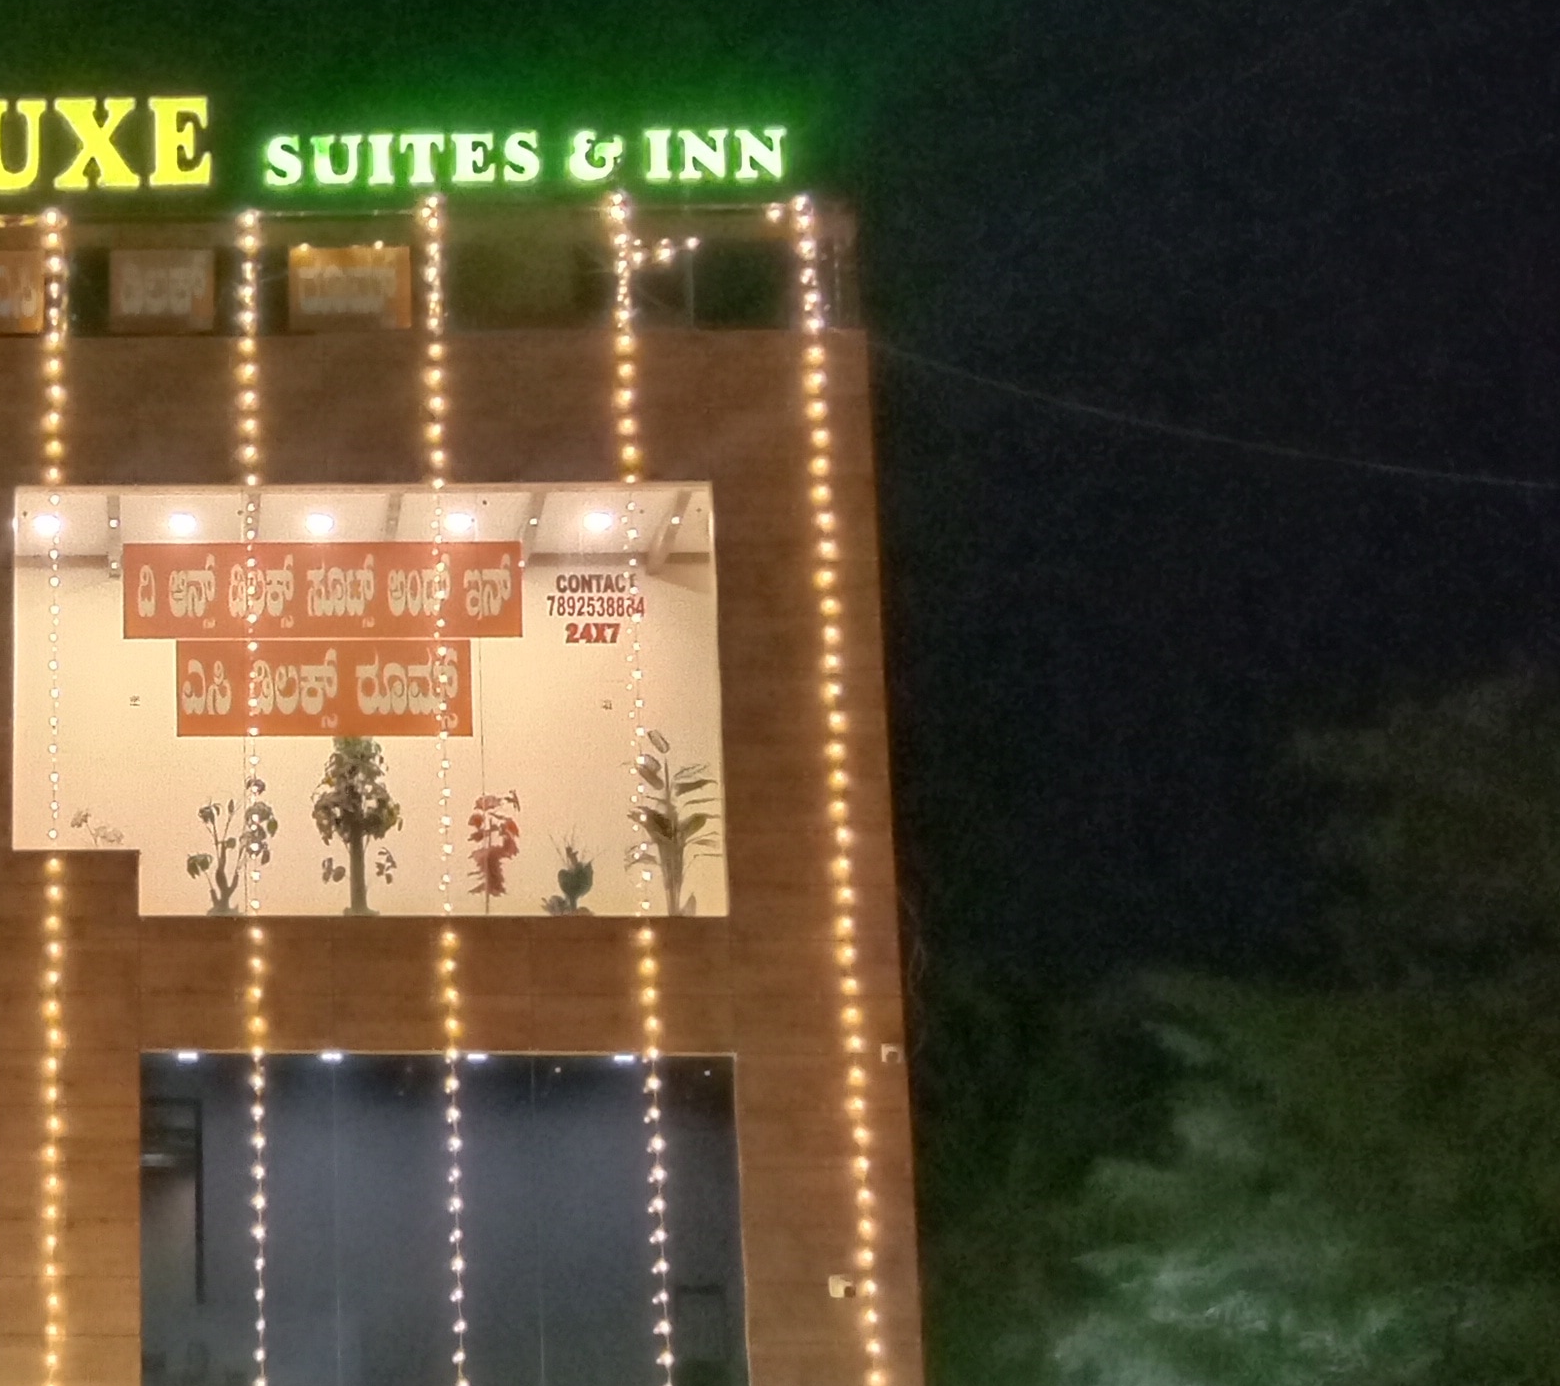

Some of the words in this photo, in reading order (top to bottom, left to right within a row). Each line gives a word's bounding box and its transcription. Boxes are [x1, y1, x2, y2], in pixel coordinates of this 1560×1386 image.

[265, 130, 539, 186] SUITES
[569, 130, 623, 182] &
[644, 128, 786, 182] INN
[138, 564, 156, 618] ದಿ
[556, 573, 636, 593] CONTACT
[565, 622, 621, 644] 24X7
